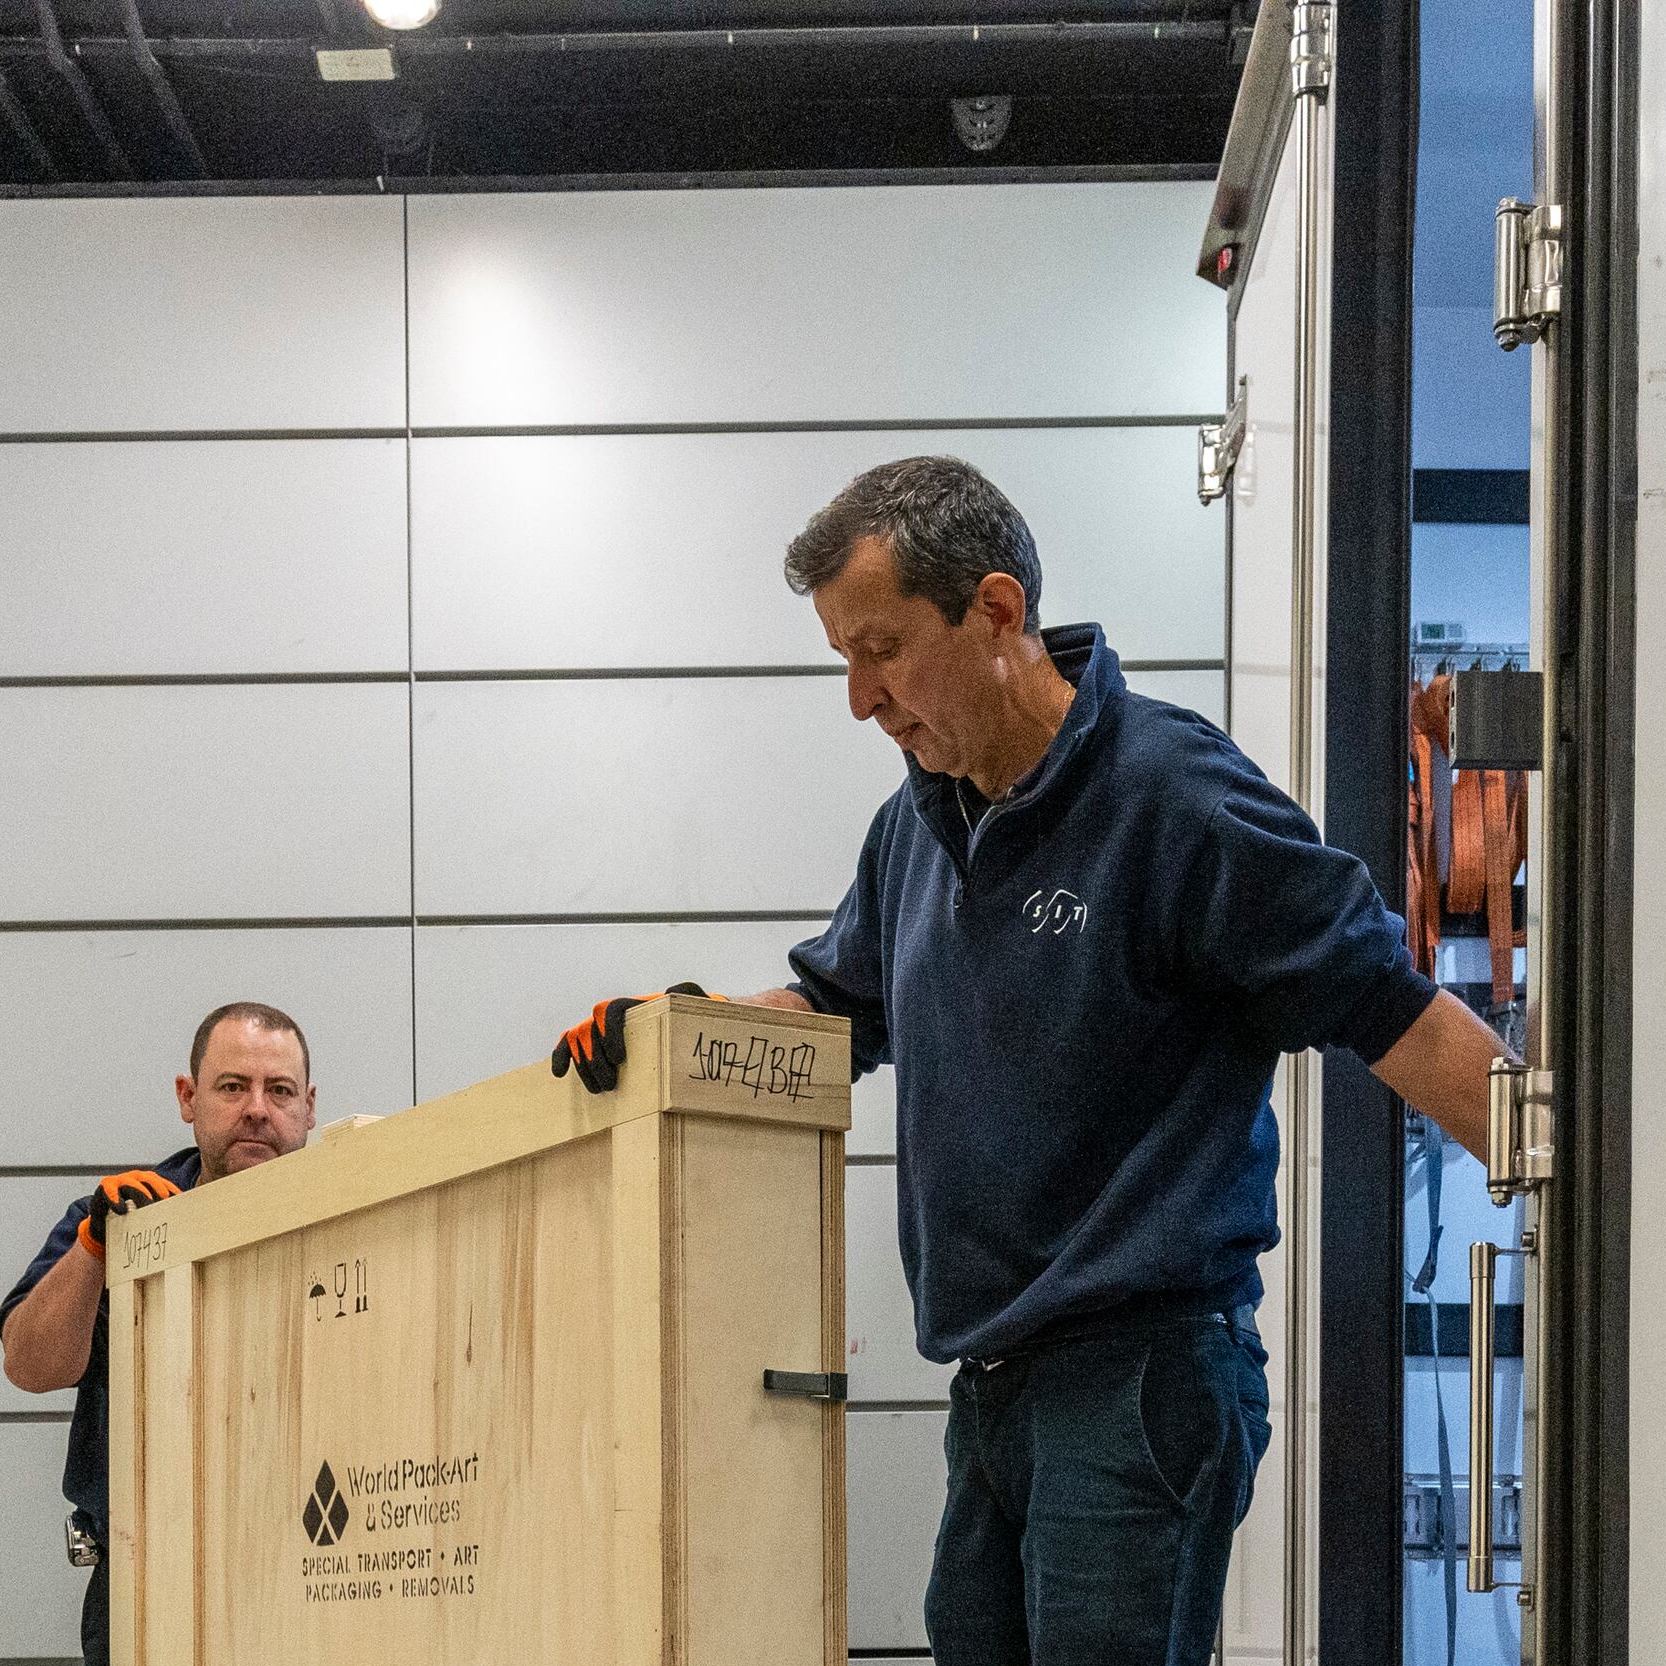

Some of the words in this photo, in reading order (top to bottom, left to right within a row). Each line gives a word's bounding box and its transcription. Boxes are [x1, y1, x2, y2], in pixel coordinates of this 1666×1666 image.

[347, 1461, 399, 1498] World
[381, 1495, 461, 1530] Services
[302, 1555, 351, 1577] SPECIAL
[357, 1548, 432, 1573] TRANSPORT
[453, 1545, 479, 1566] ART
[305, 1580, 382, 1603] PACKAGING
[401, 1574, 475, 1598] REMOVALS
